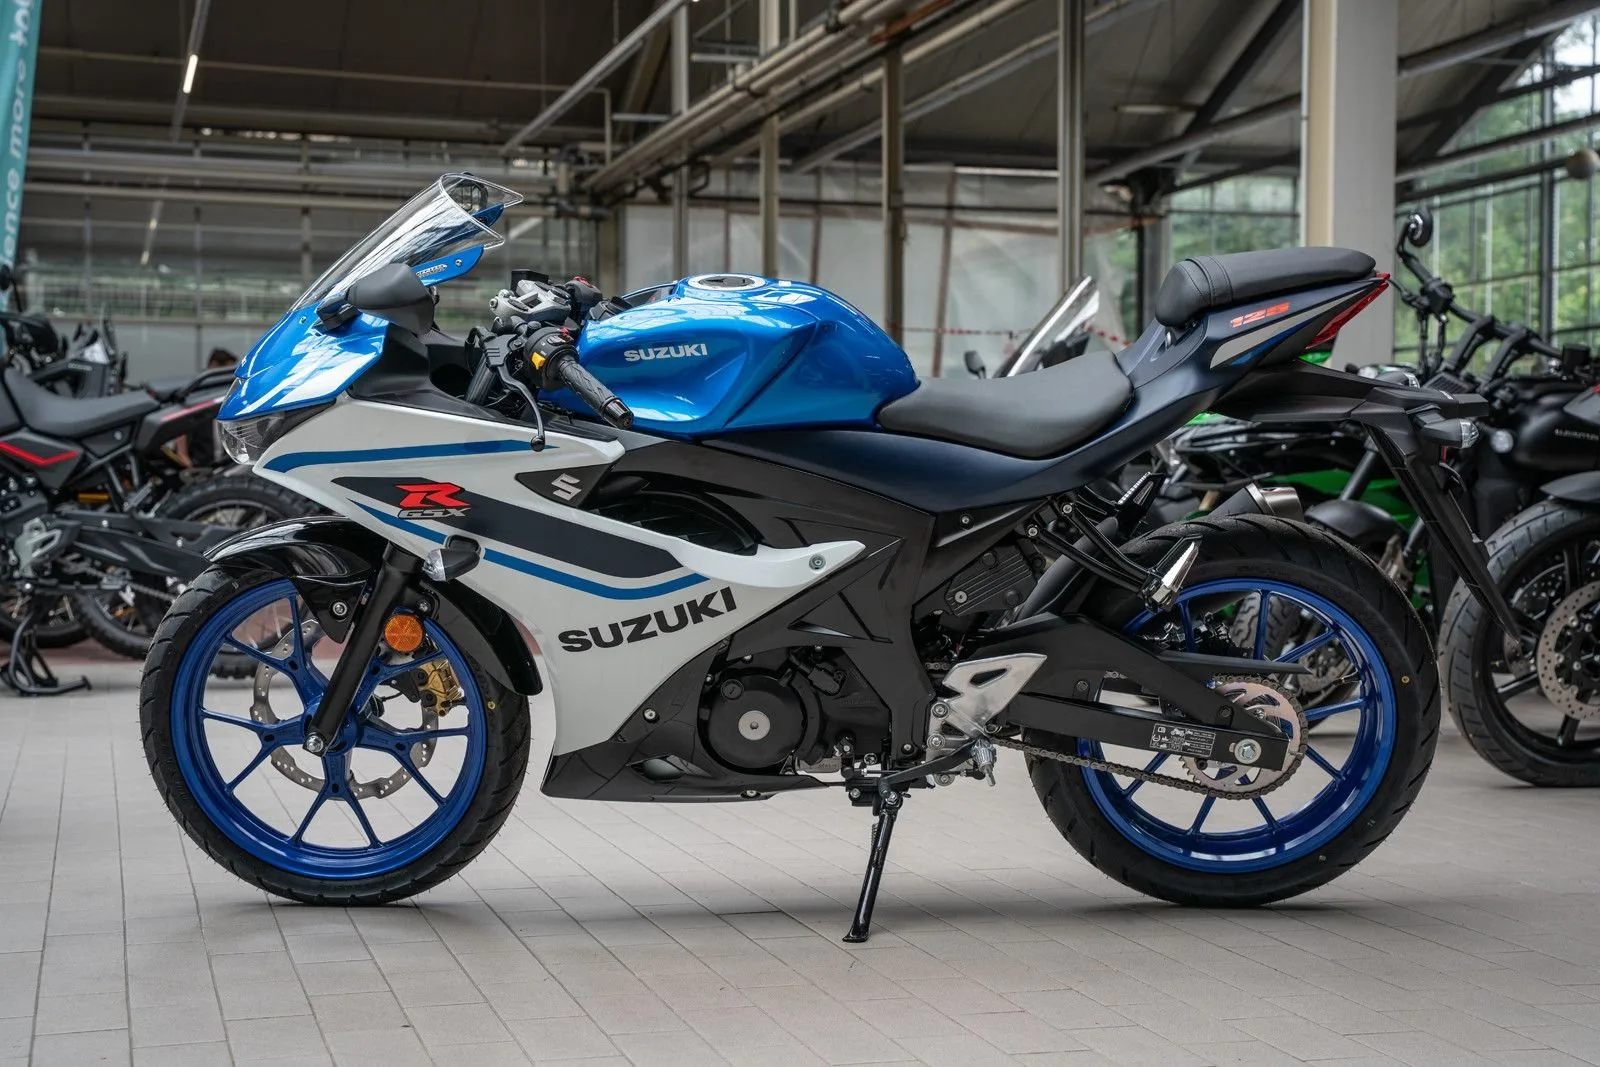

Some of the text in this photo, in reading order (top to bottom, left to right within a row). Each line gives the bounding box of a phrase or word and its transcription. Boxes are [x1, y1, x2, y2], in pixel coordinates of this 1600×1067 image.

[1230, 302, 1290, 328] 125
[624, 343, 707, 362] SUZUKI
[393, 482, 472, 508] R
[398, 507, 472, 519] GSX
[558, 586, 737, 653] SUZUKI
